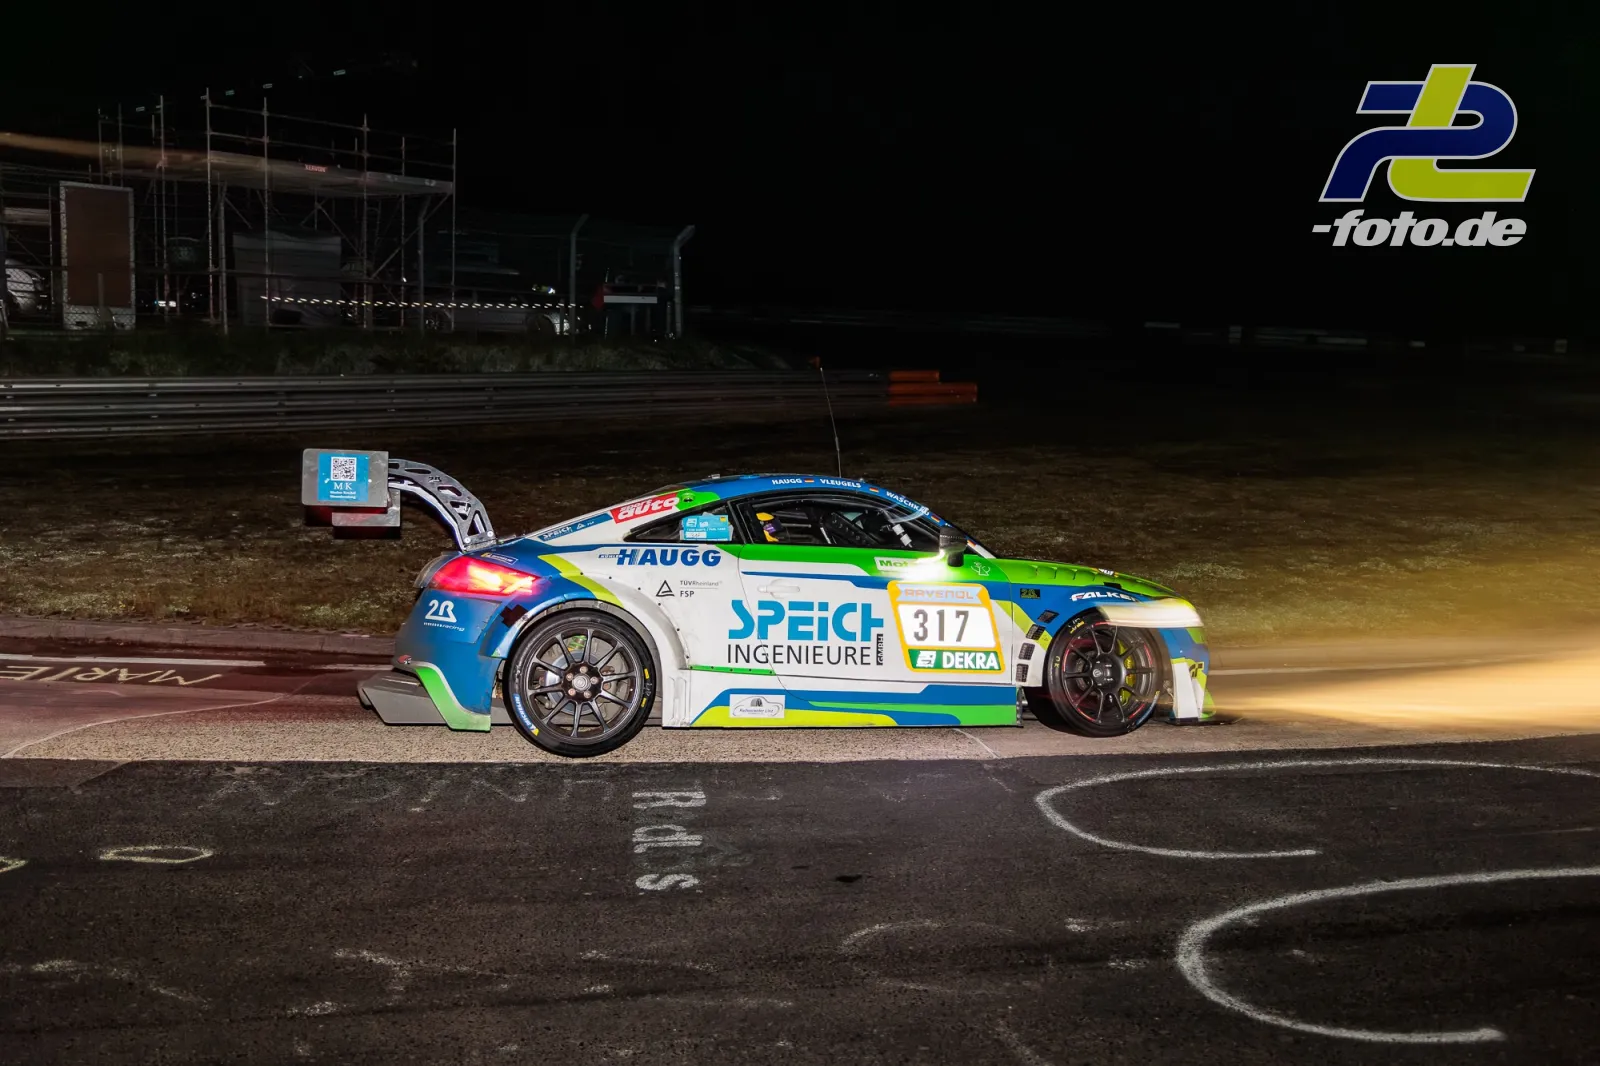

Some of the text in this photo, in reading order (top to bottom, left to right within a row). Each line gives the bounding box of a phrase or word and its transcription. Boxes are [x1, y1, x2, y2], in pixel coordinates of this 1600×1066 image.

[820, 478, 861, 488] VLEUGELS
[617, 497, 680, 520] auto
[617, 549, 721, 567] HAUGG
[904, 588, 974, 599] RAVENOL
[914, 609, 969, 642] 317
[728, 644, 871, 665] INGENIEURE
[942, 652, 999, 670] DEKRA
